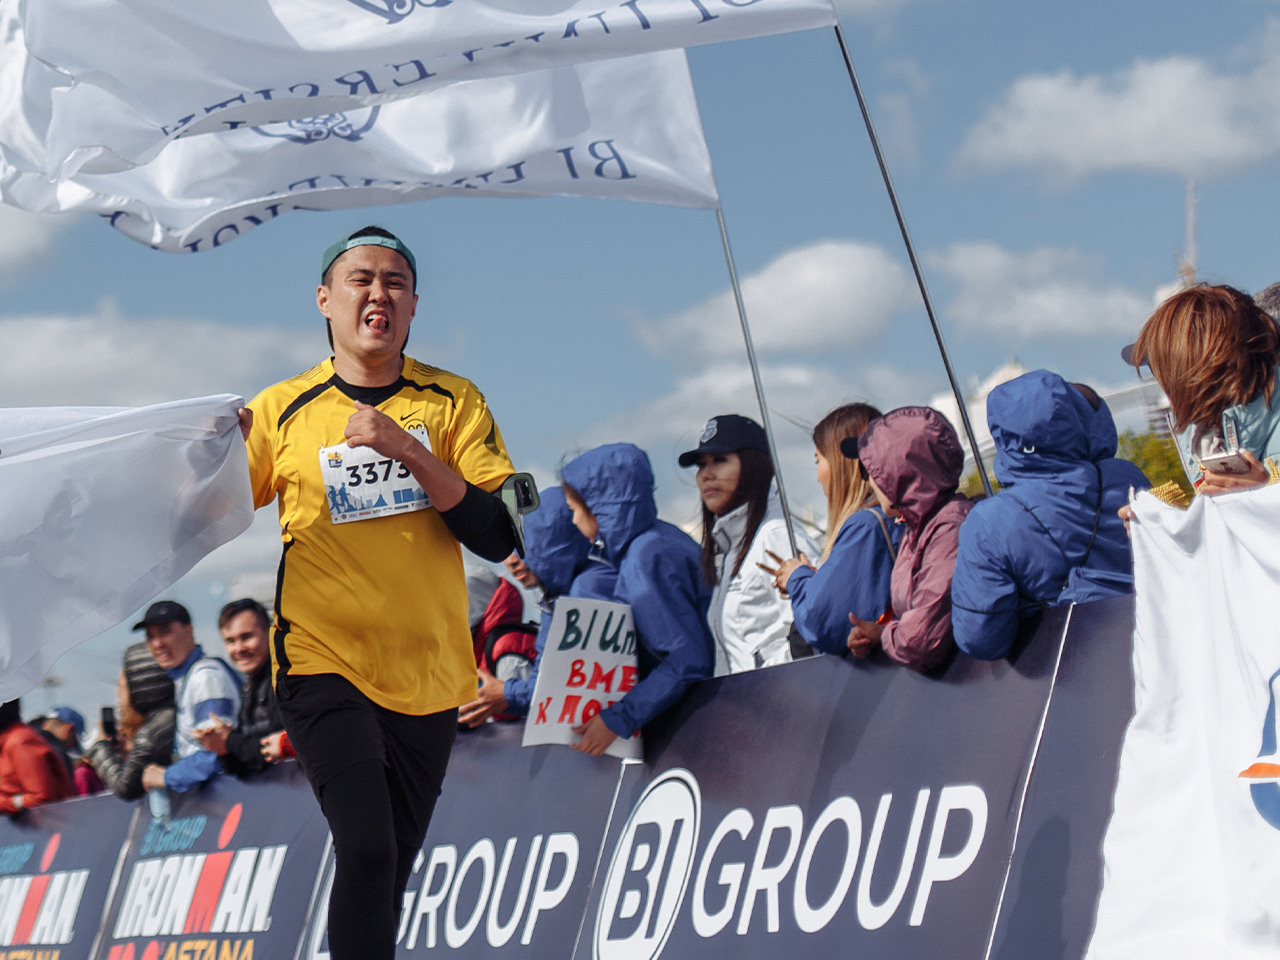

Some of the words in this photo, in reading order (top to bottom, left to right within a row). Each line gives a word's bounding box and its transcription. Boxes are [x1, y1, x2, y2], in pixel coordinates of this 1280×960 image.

[345, 458, 412, 488] 3373
[598, 611, 638, 657] Un
[111, 844, 289, 940] IRONMAN
[607, 817, 685, 941] BI
[691, 784, 989, 938] GROUP
